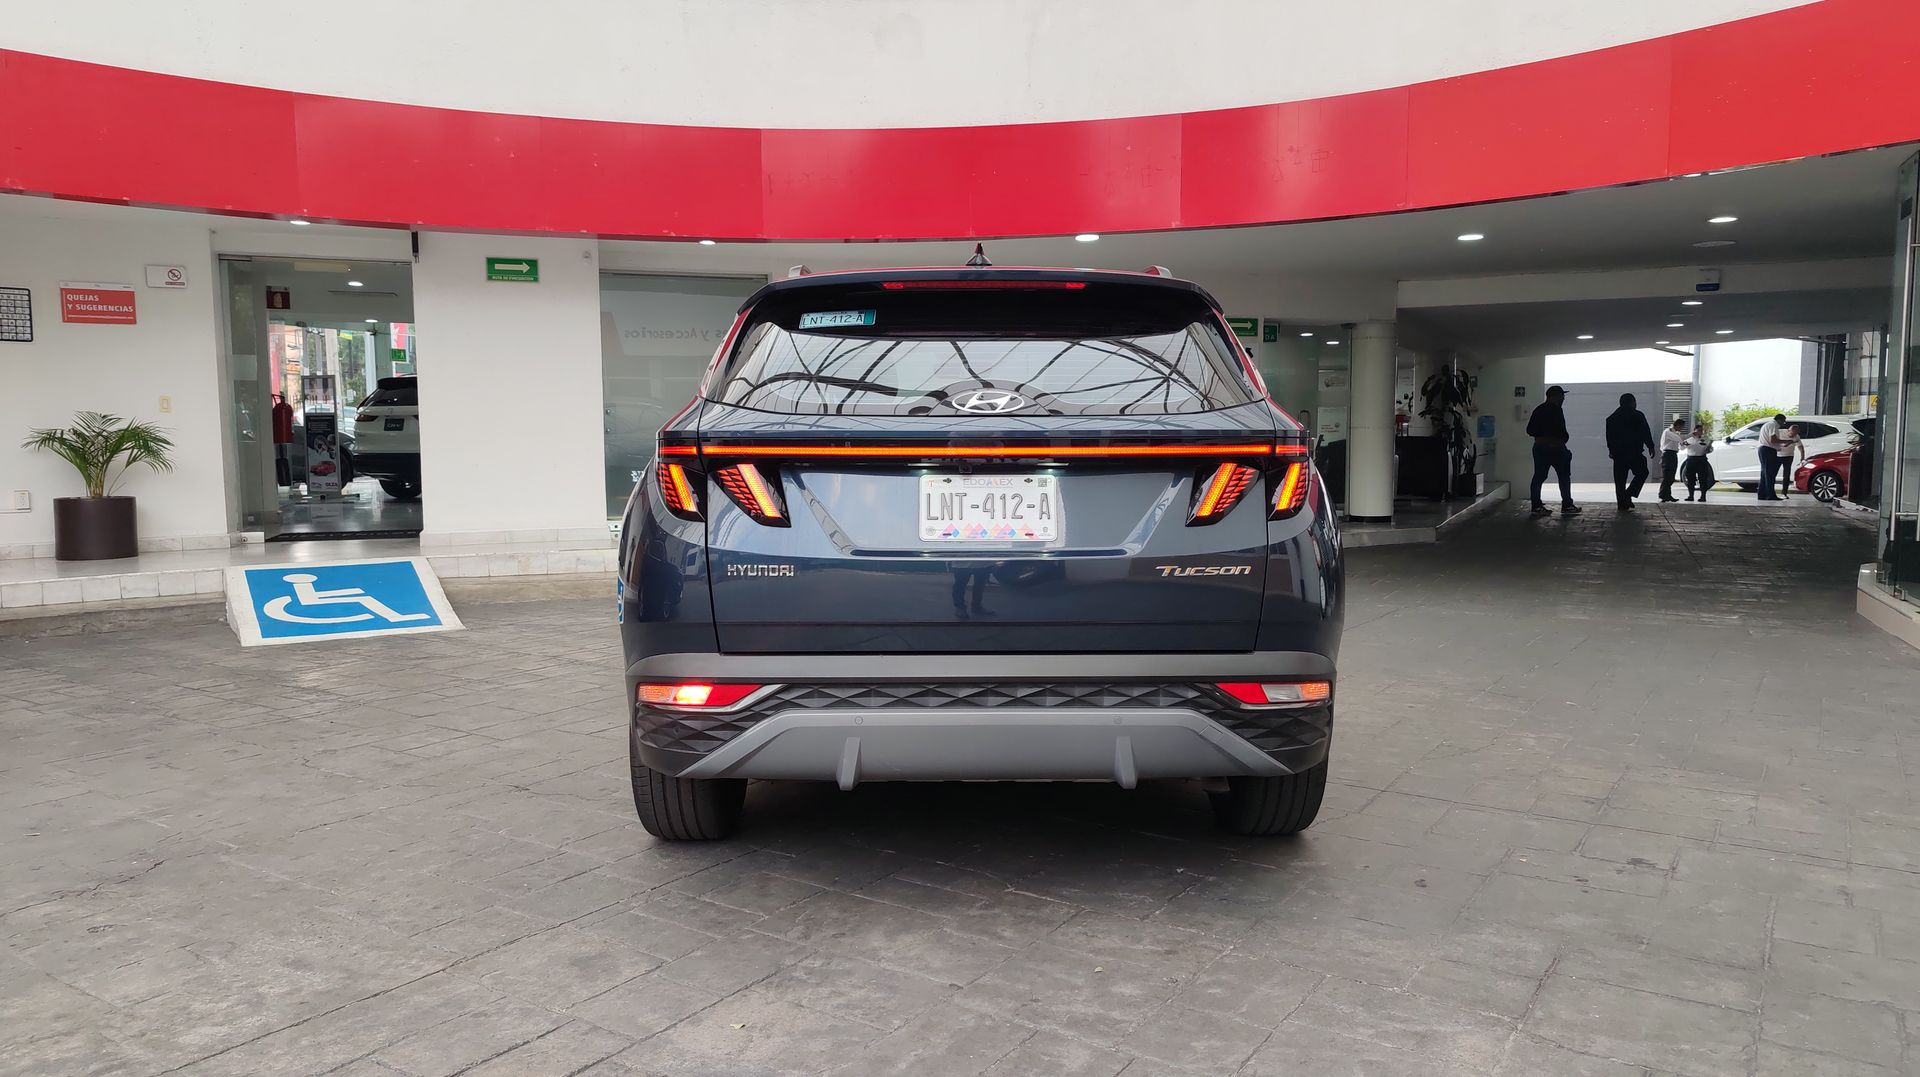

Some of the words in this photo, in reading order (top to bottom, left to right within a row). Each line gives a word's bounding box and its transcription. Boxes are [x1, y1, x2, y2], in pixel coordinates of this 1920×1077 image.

[66, 294, 100, 302] QUEJAS
[75, 304, 134, 313] SUGERENCIAS
[803, 314, 863, 326] LNT-412-A
[926, 492, 1051, 521] LNT-412-A
[727, 564, 795, 577] HYUNDAI
